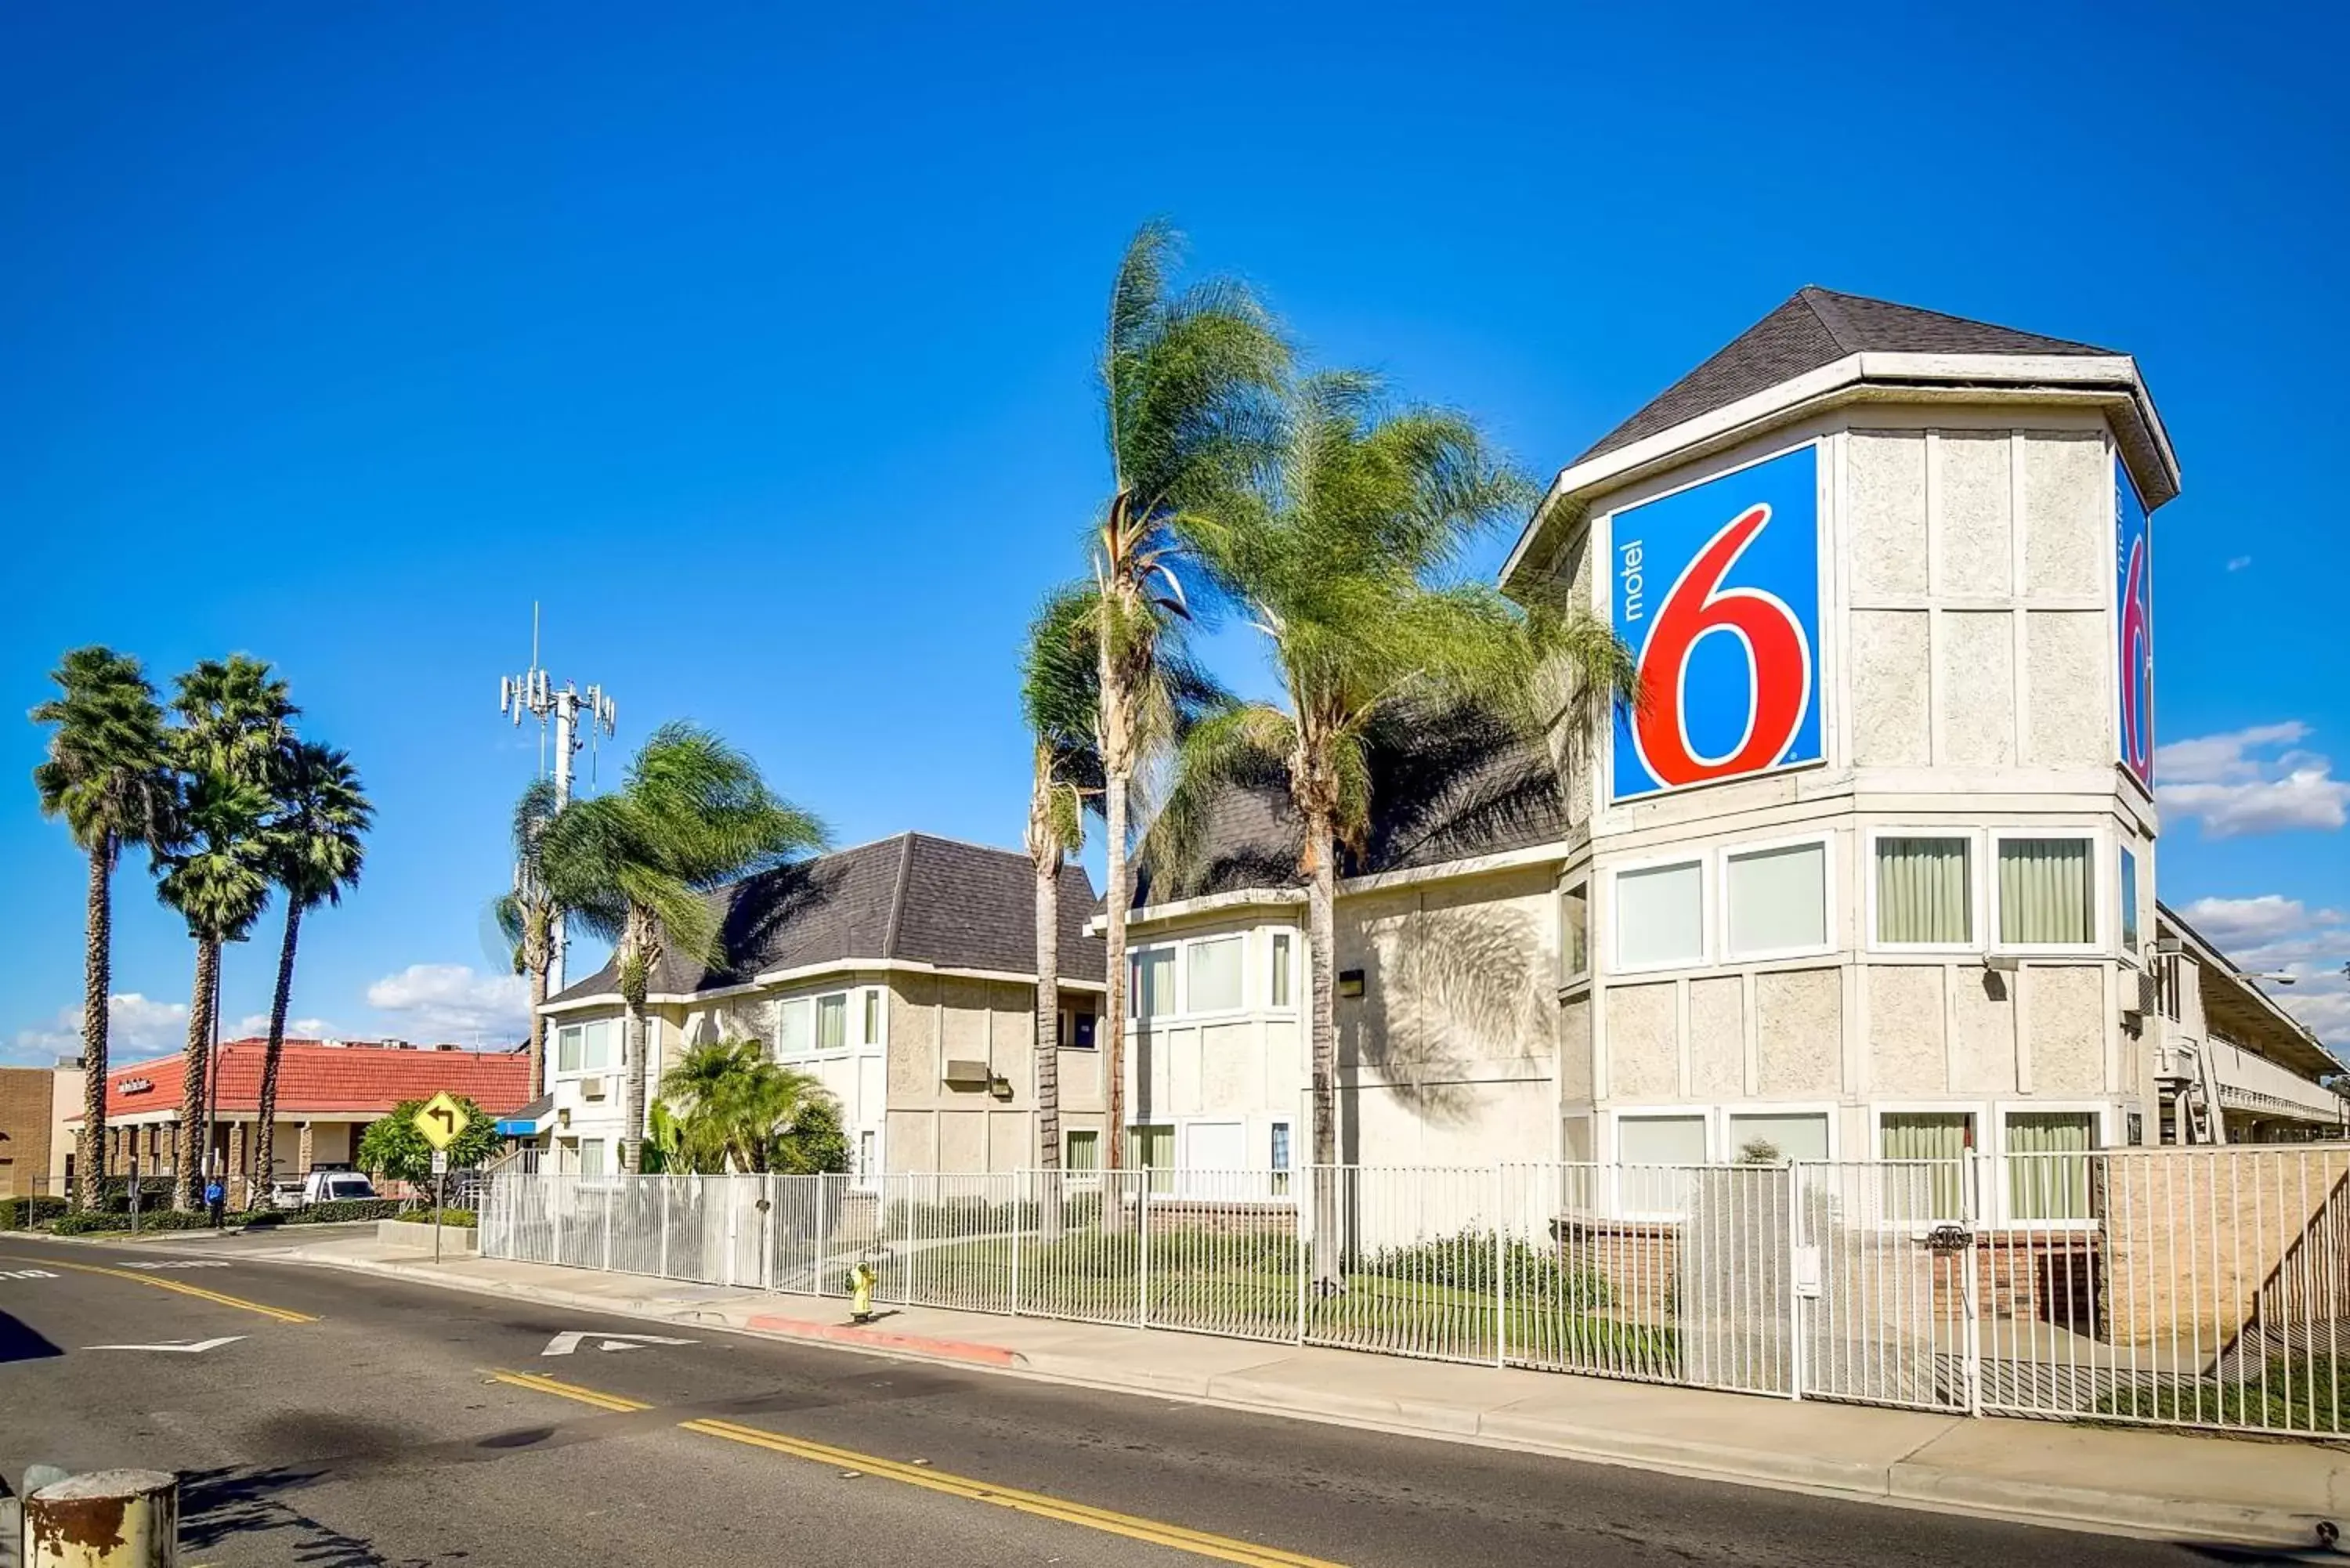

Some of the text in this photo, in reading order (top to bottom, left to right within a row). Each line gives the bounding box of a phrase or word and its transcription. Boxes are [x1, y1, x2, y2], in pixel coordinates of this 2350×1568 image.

[1618, 539, 1643, 622] motel
[2115, 485, 2125, 575] motel
[1631, 502, 1812, 789] 6
[2120, 533, 2150, 786] 6
